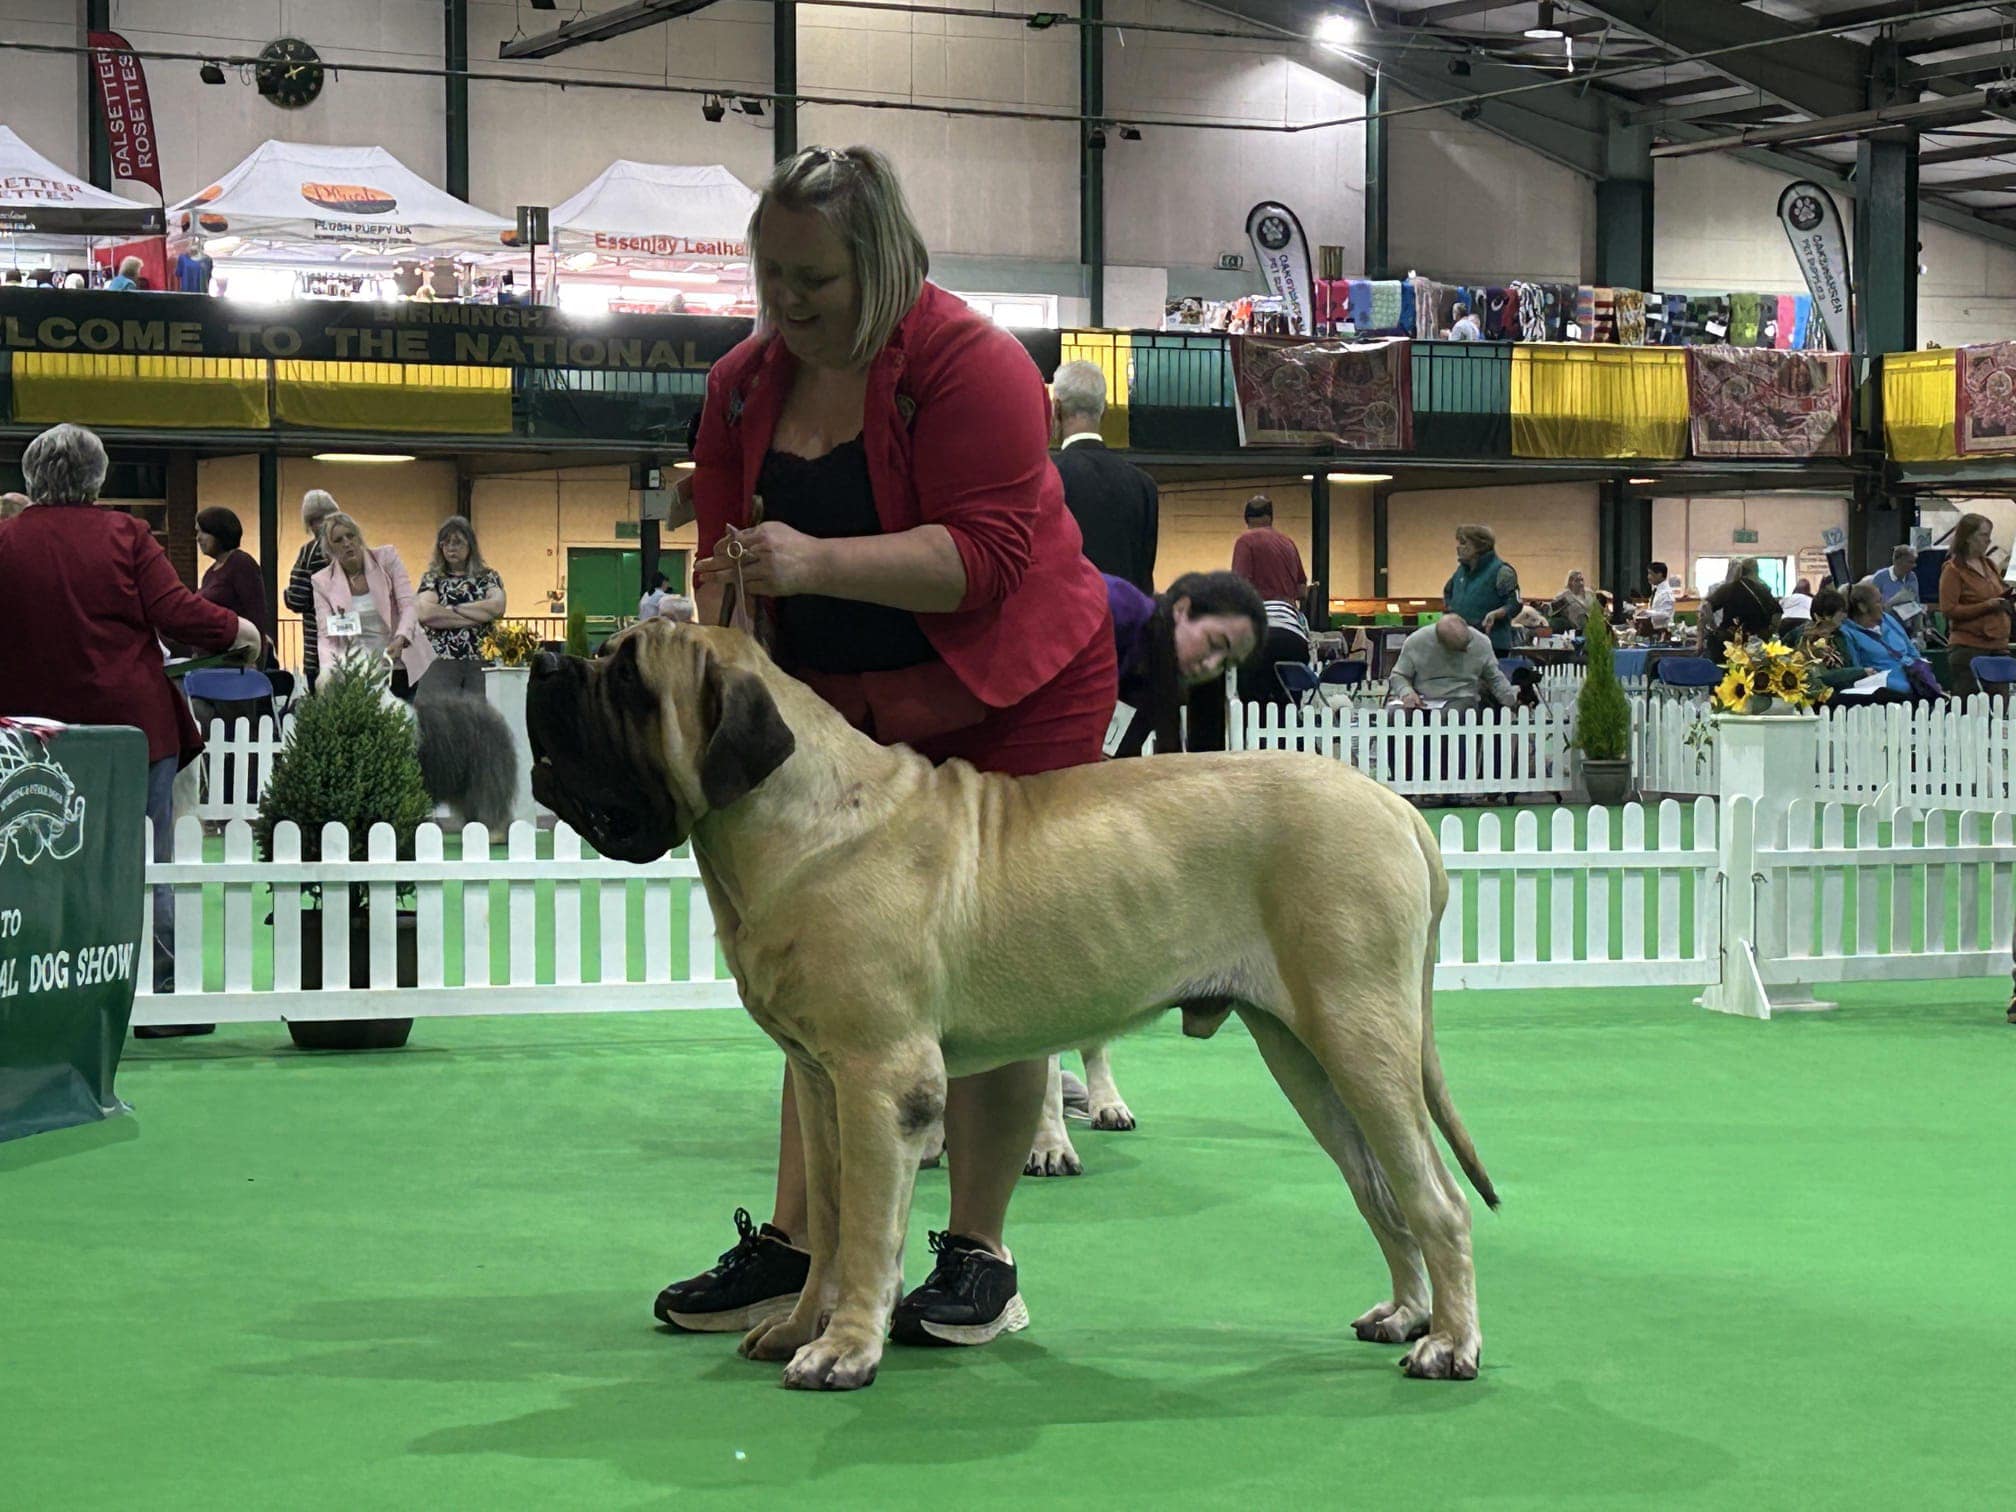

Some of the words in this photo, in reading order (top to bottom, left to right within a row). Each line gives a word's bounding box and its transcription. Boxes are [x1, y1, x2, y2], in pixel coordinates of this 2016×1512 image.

[119, 54, 152, 168] ROSETTES
[0, 176, 83, 193] ETTER
[396, 224, 412, 235] UK
[594, 232, 678, 256] Essenjay
[684, 237, 748, 257] Leathe
[373, 302, 563, 330] BIRMINGH
[0, 316, 203, 352] LCOME
[227, 323, 302, 356] TO
[325, 327, 430, 361] THE
[455, 333, 711, 369] NATIONAL
[1, 908, 22, 938] TO
[29, 950, 70, 993] DOG
[76, 942, 134, 987] SHOW
